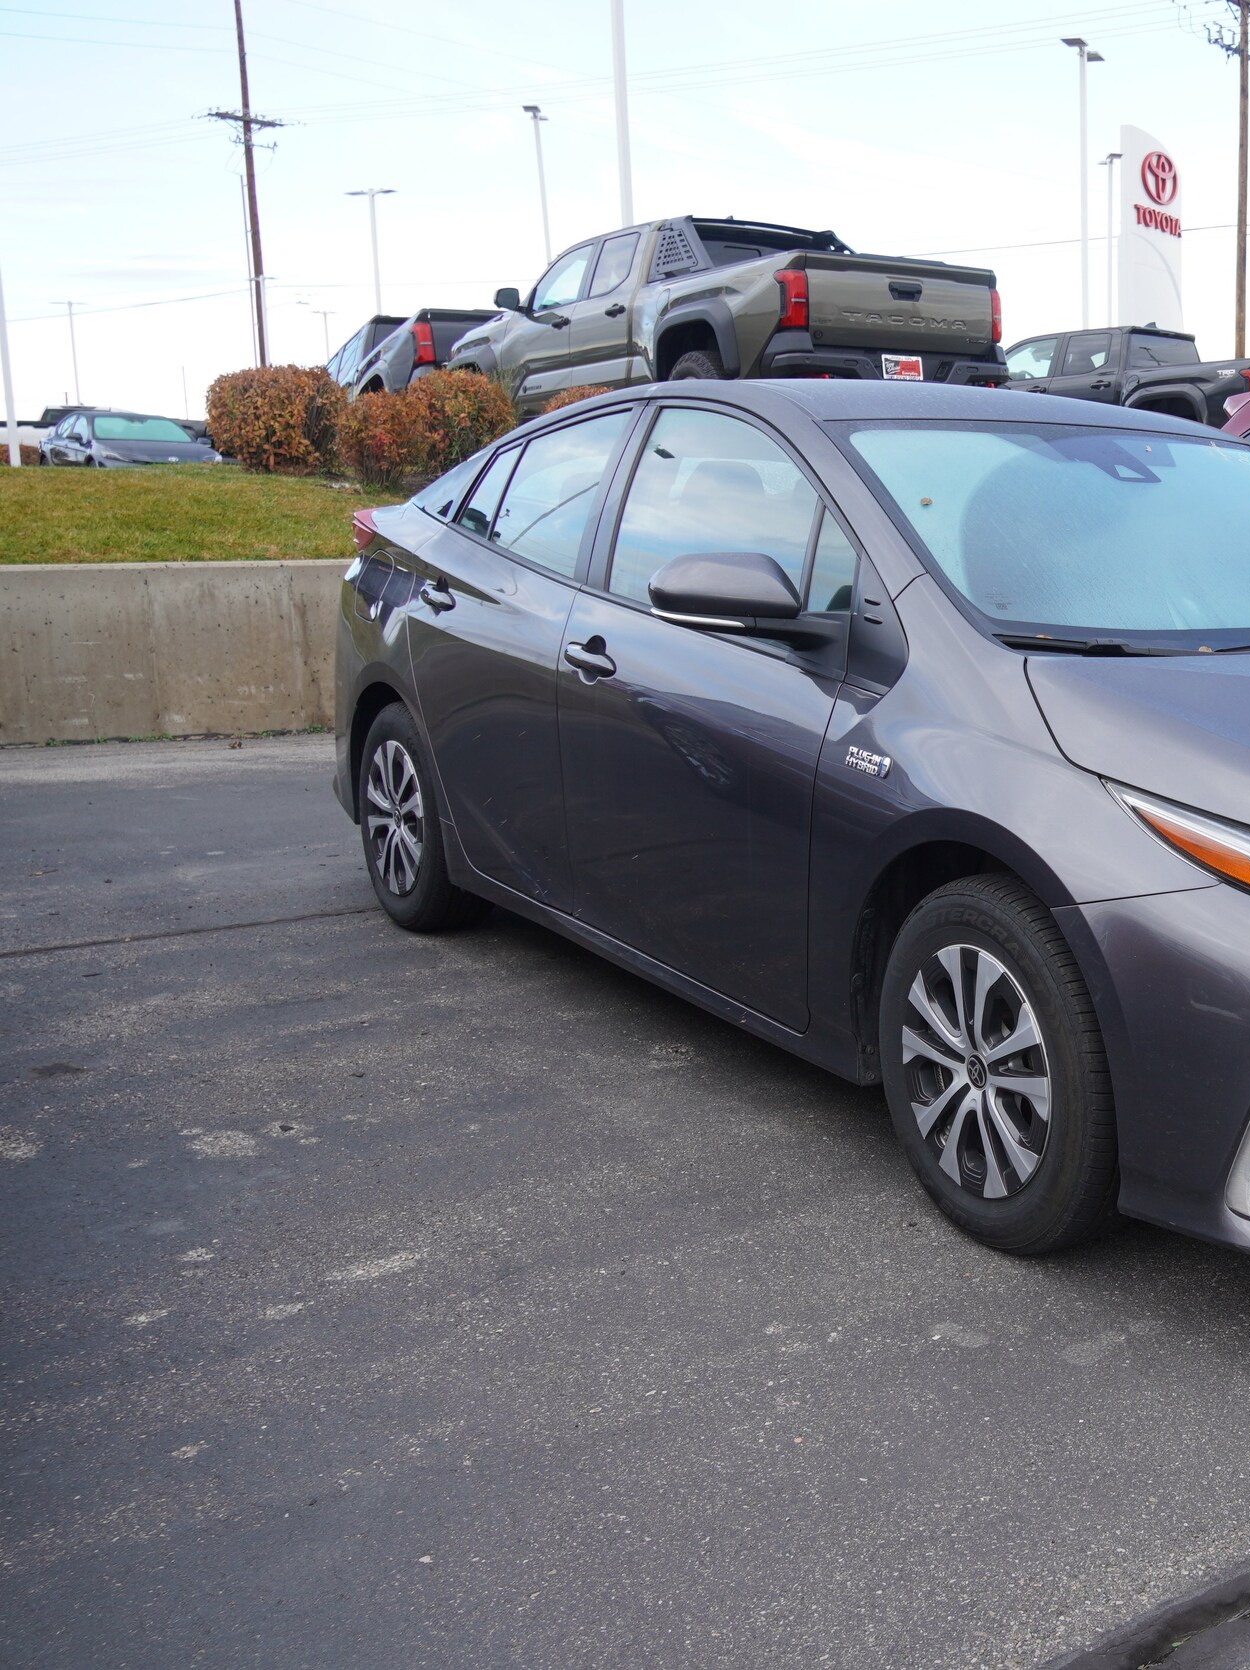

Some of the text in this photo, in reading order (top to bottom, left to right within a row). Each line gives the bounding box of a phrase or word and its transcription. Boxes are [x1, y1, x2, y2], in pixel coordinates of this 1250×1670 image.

[1133, 203, 1182, 238] TOYOTA
[841, 310, 967, 330] TACOMA
[845, 755, 878, 775] HYBRID
[848, 746, 881, 765] PLUG-IN
[907, 906, 1046, 991] STERCRAFT
